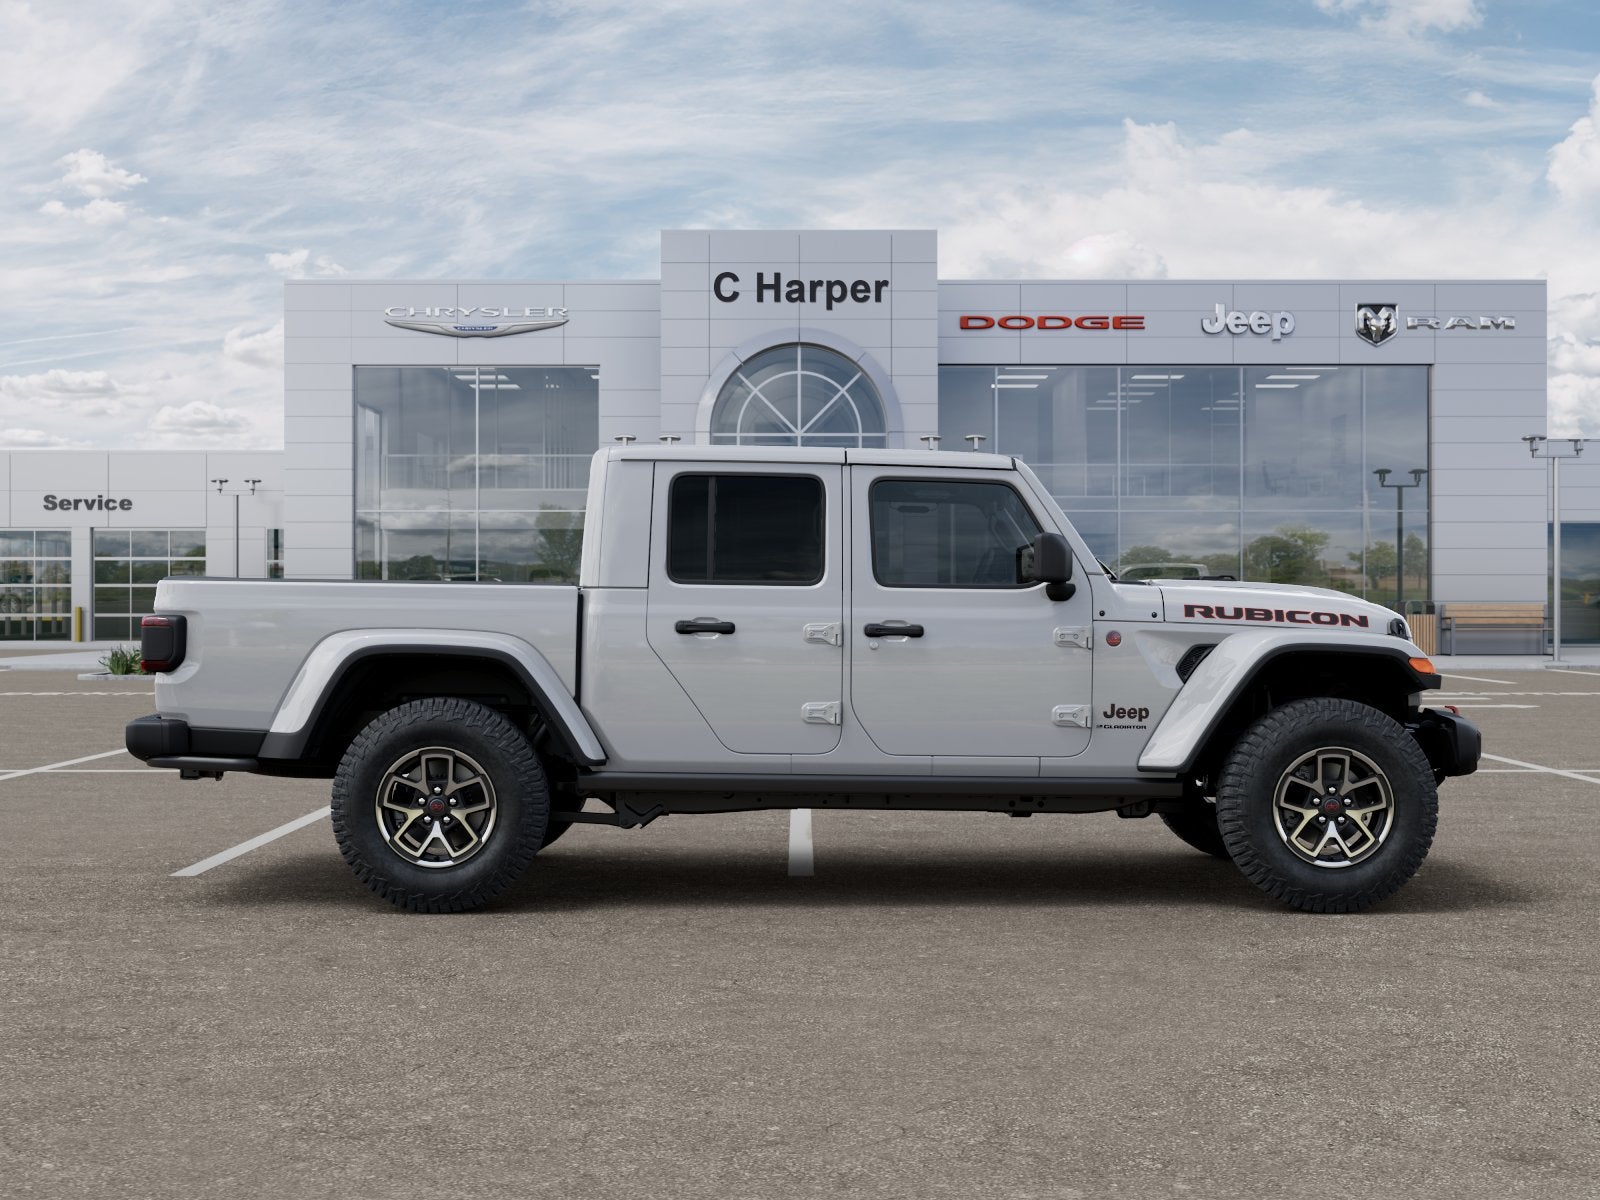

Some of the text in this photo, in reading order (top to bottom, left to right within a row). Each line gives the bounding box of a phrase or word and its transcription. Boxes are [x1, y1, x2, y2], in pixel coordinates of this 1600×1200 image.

[713, 271, 890, 311] C Harper
[384, 306, 569, 318] CHRYSLER
[959, 315, 1146, 330] DODGE
[1200, 302, 1297, 342] Jeep
[1406, 316, 1516, 330] RAM
[43, 494, 133, 511] Service
[1183, 604, 1369, 628] RUBICON
[1102, 703, 1150, 722] Jeep
